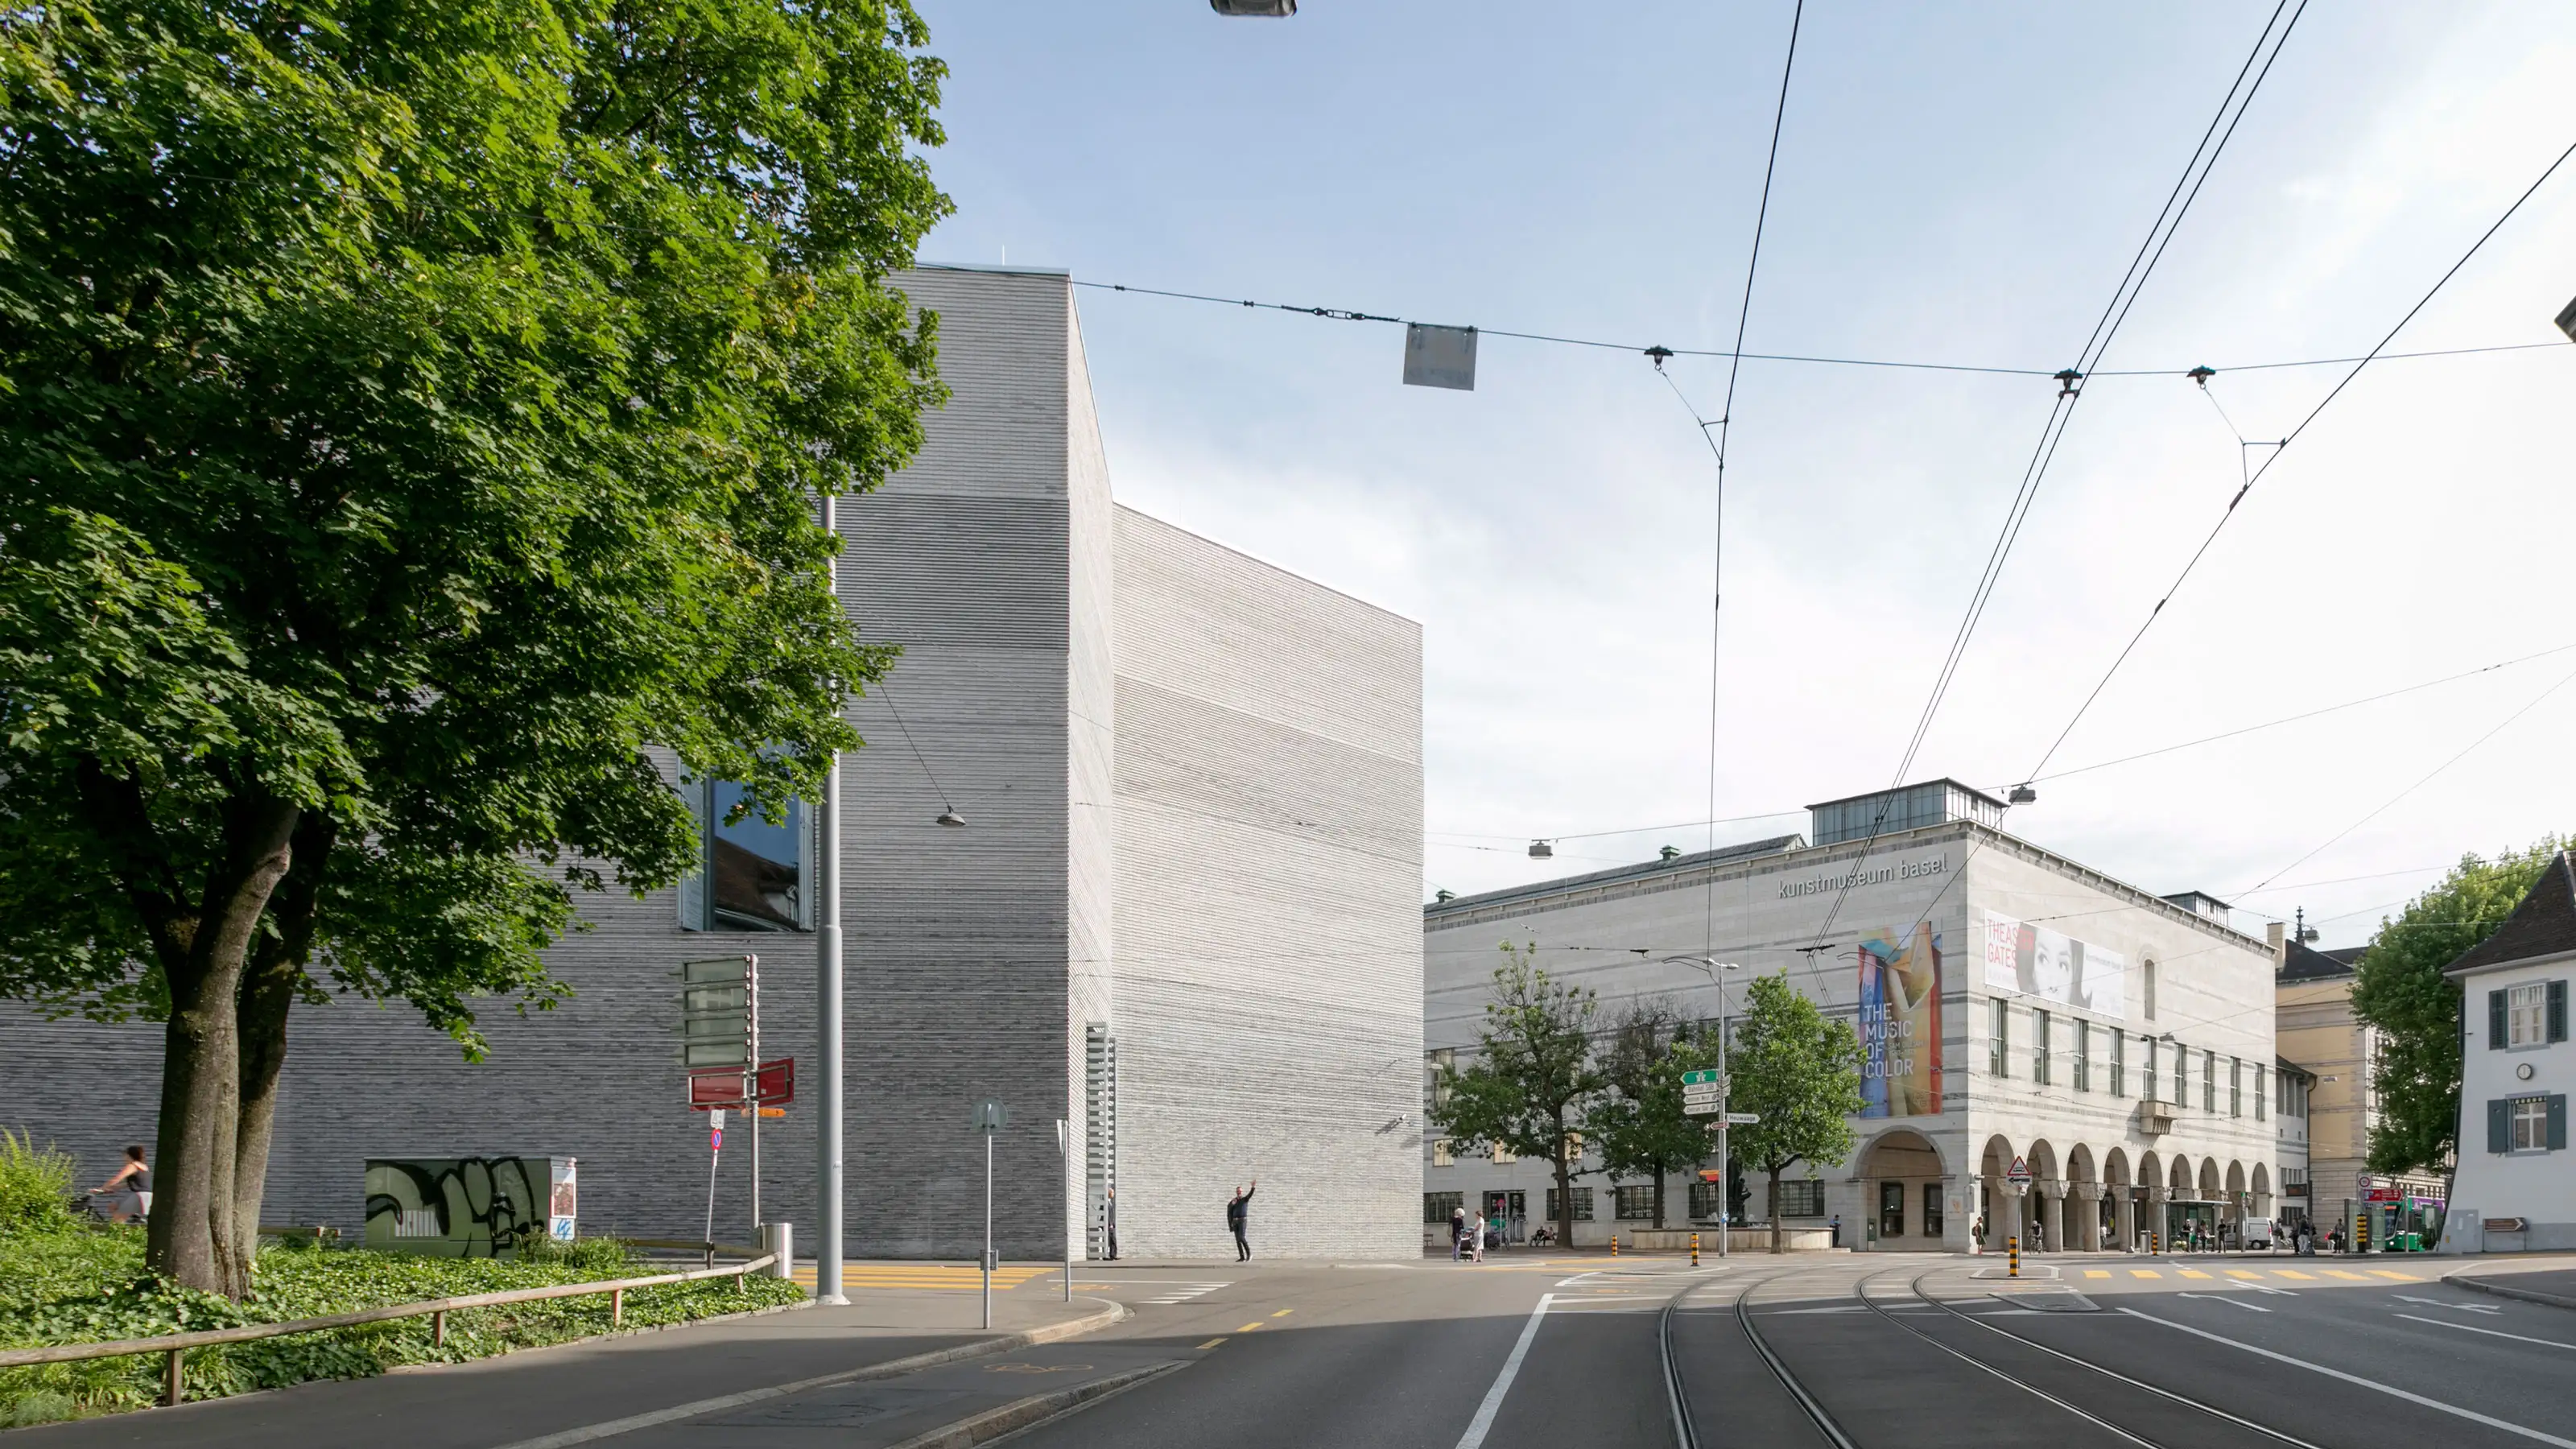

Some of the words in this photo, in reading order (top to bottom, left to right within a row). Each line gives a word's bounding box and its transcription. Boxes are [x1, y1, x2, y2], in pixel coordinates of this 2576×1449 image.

[1778, 866, 1894, 899] kunstmuseum
[1900, 852, 1948, 879] basel
[1987, 918, 2035, 952] THEASTER
[1987, 942, 2017, 969] GATES
[1864, 1002, 1893, 1022] THE
[1864, 1020, 1913, 1041] MUSIC
[1865, 1042, 1885, 1060] OF
[1865, 1059, 1914, 1079] COLOR
[1729, 1114, 1756, 1123] Heuwaage
